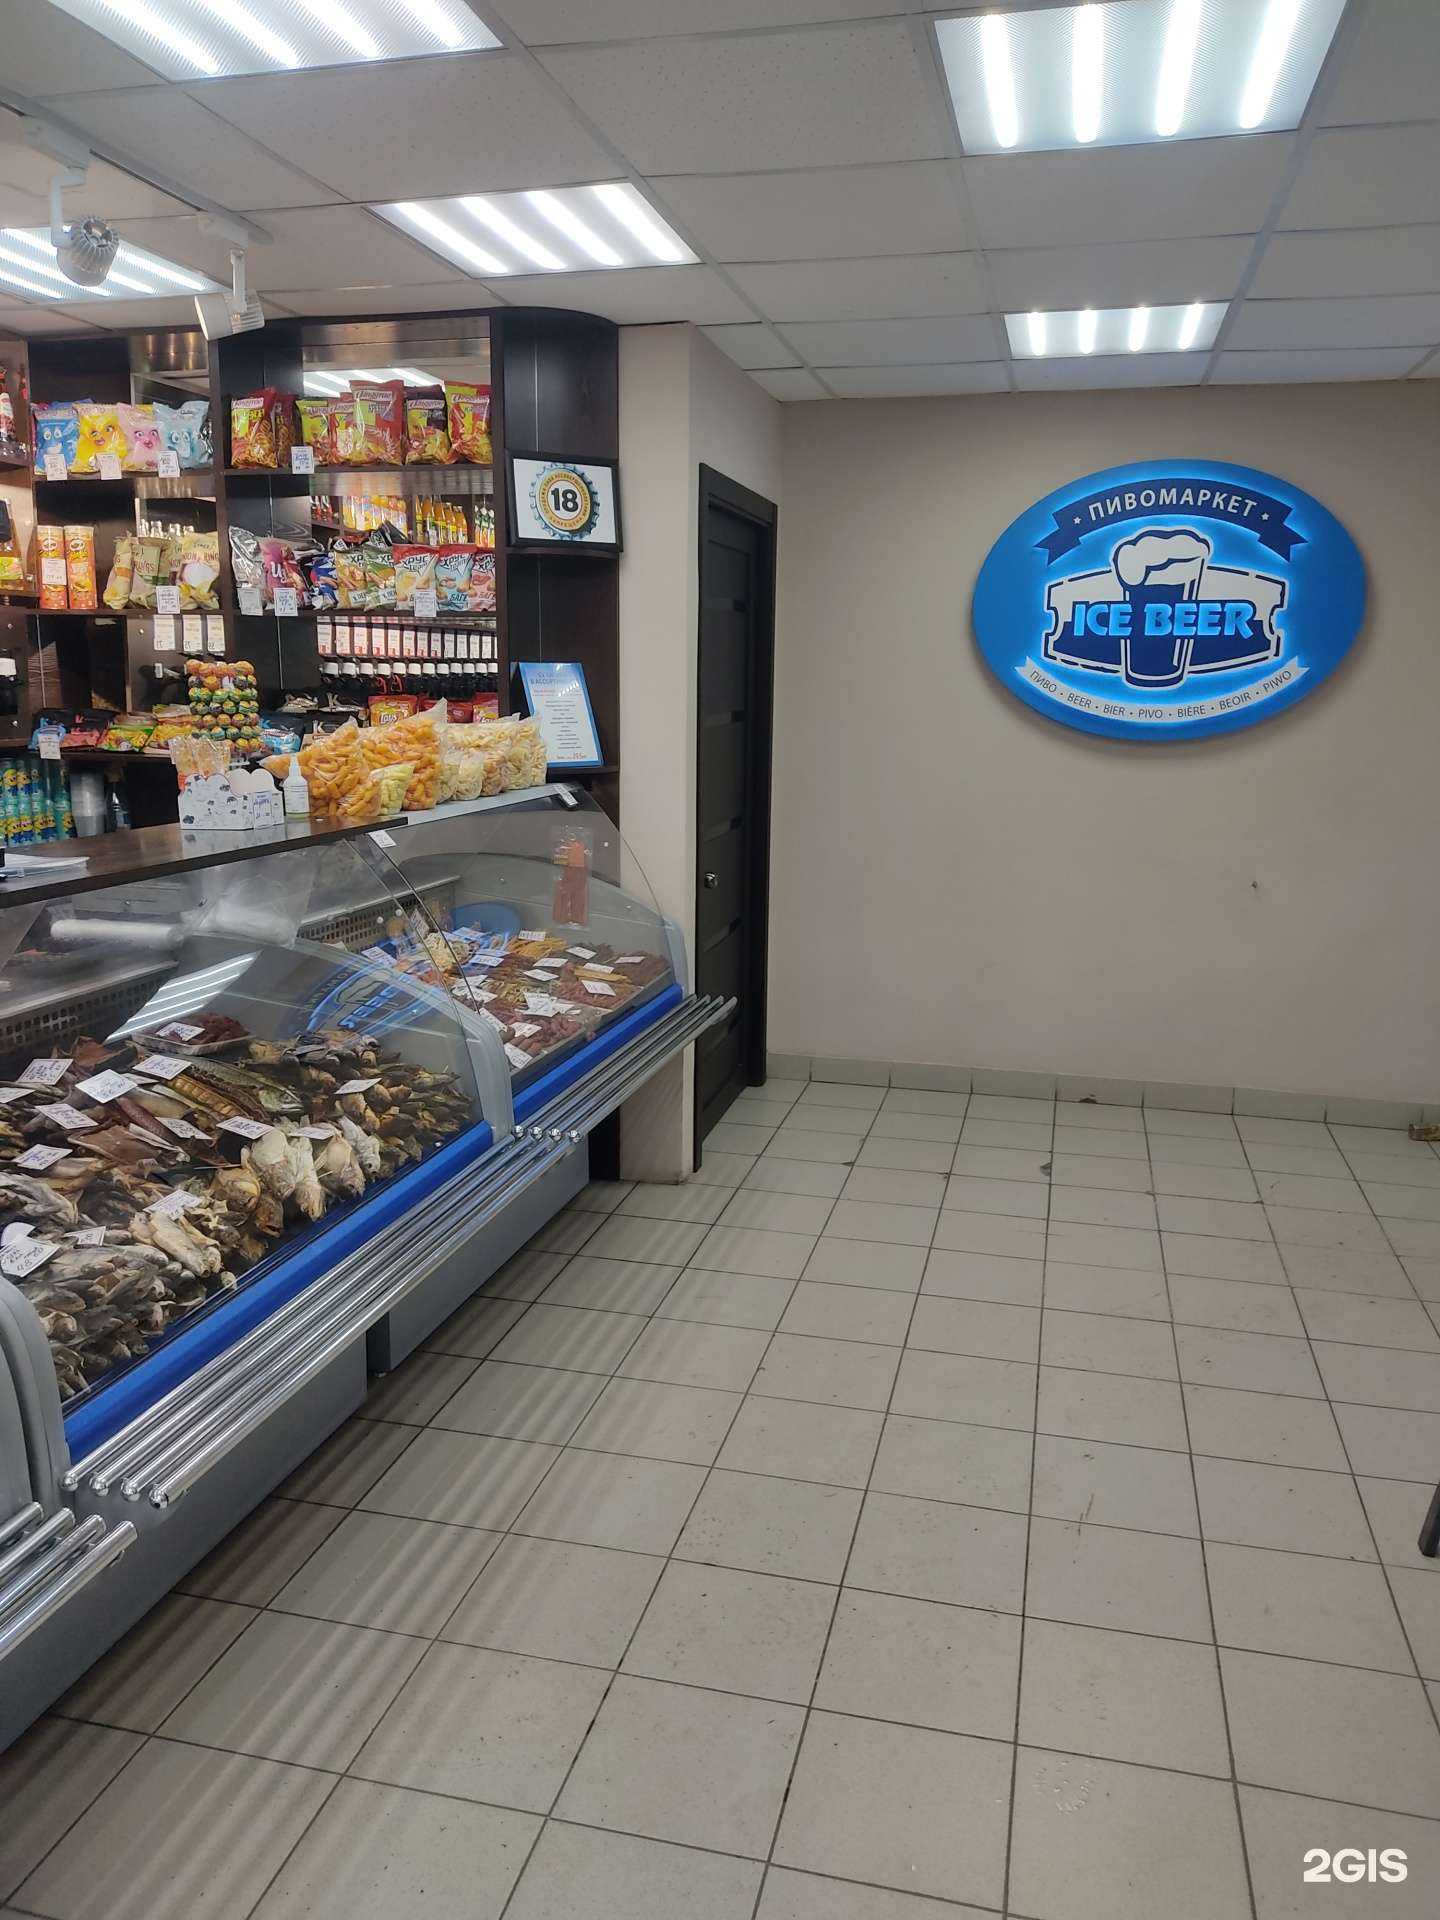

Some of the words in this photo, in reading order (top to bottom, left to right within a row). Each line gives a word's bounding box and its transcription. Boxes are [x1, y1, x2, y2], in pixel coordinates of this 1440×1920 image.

[551, 487, 579, 513] 18
[1088, 488, 1258, 521] ПИВОМАРКЕТ
[1073, 603, 1133, 636] ICE
[1144, 602, 1254, 639] BEER
[1030, 670, 1057, 693] ПИВО
[1067, 692, 1092, 709] BEER
[1103, 703, 1126, 717] BIER
[1138, 708, 1163, 719] PIVO
[1218, 691, 1252, 711] BEOIR
[1263, 670, 1292, 693] PIWO
